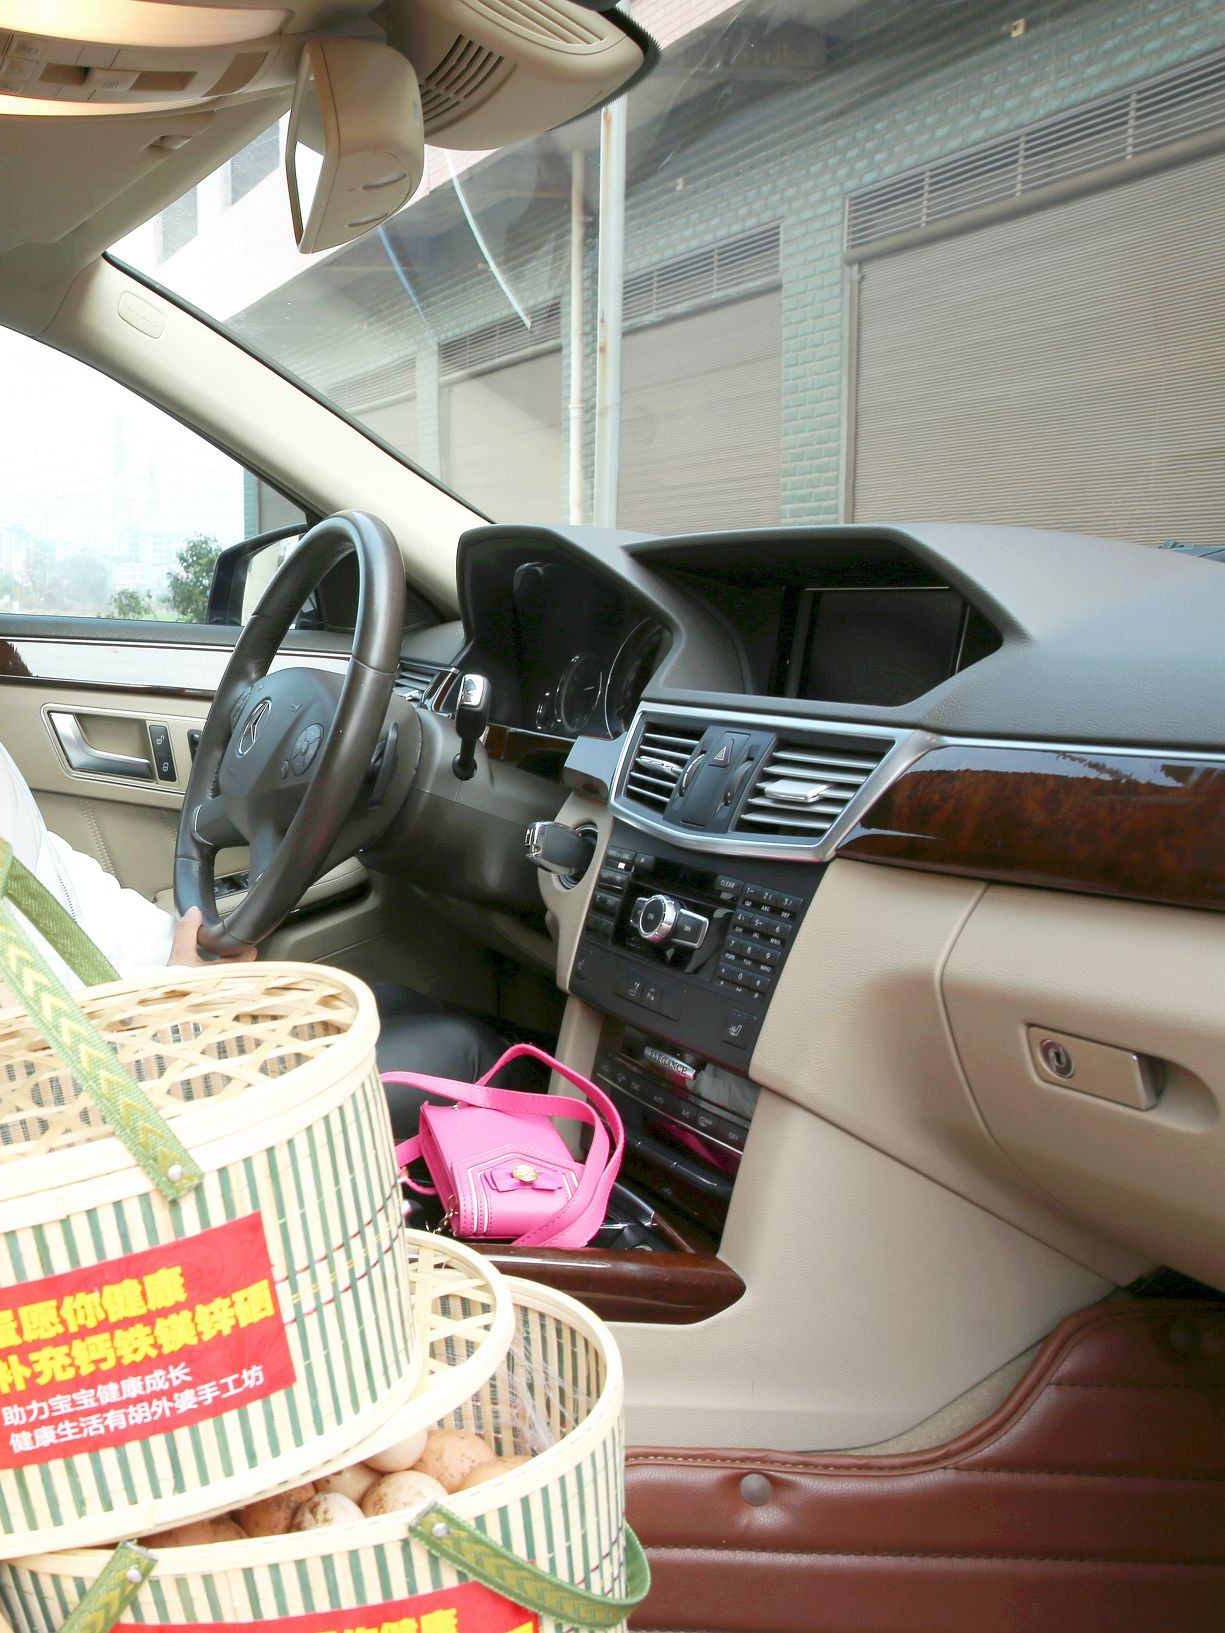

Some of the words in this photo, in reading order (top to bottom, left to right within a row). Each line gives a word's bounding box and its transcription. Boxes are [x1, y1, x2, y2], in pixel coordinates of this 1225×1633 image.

[720, 880, 736, 888] CLEAR
[1, 1362, 193, 1427] 助力宝宝健康成长
[9, 1364, 265, 1454] 健康生活有胡外婆手工坊
